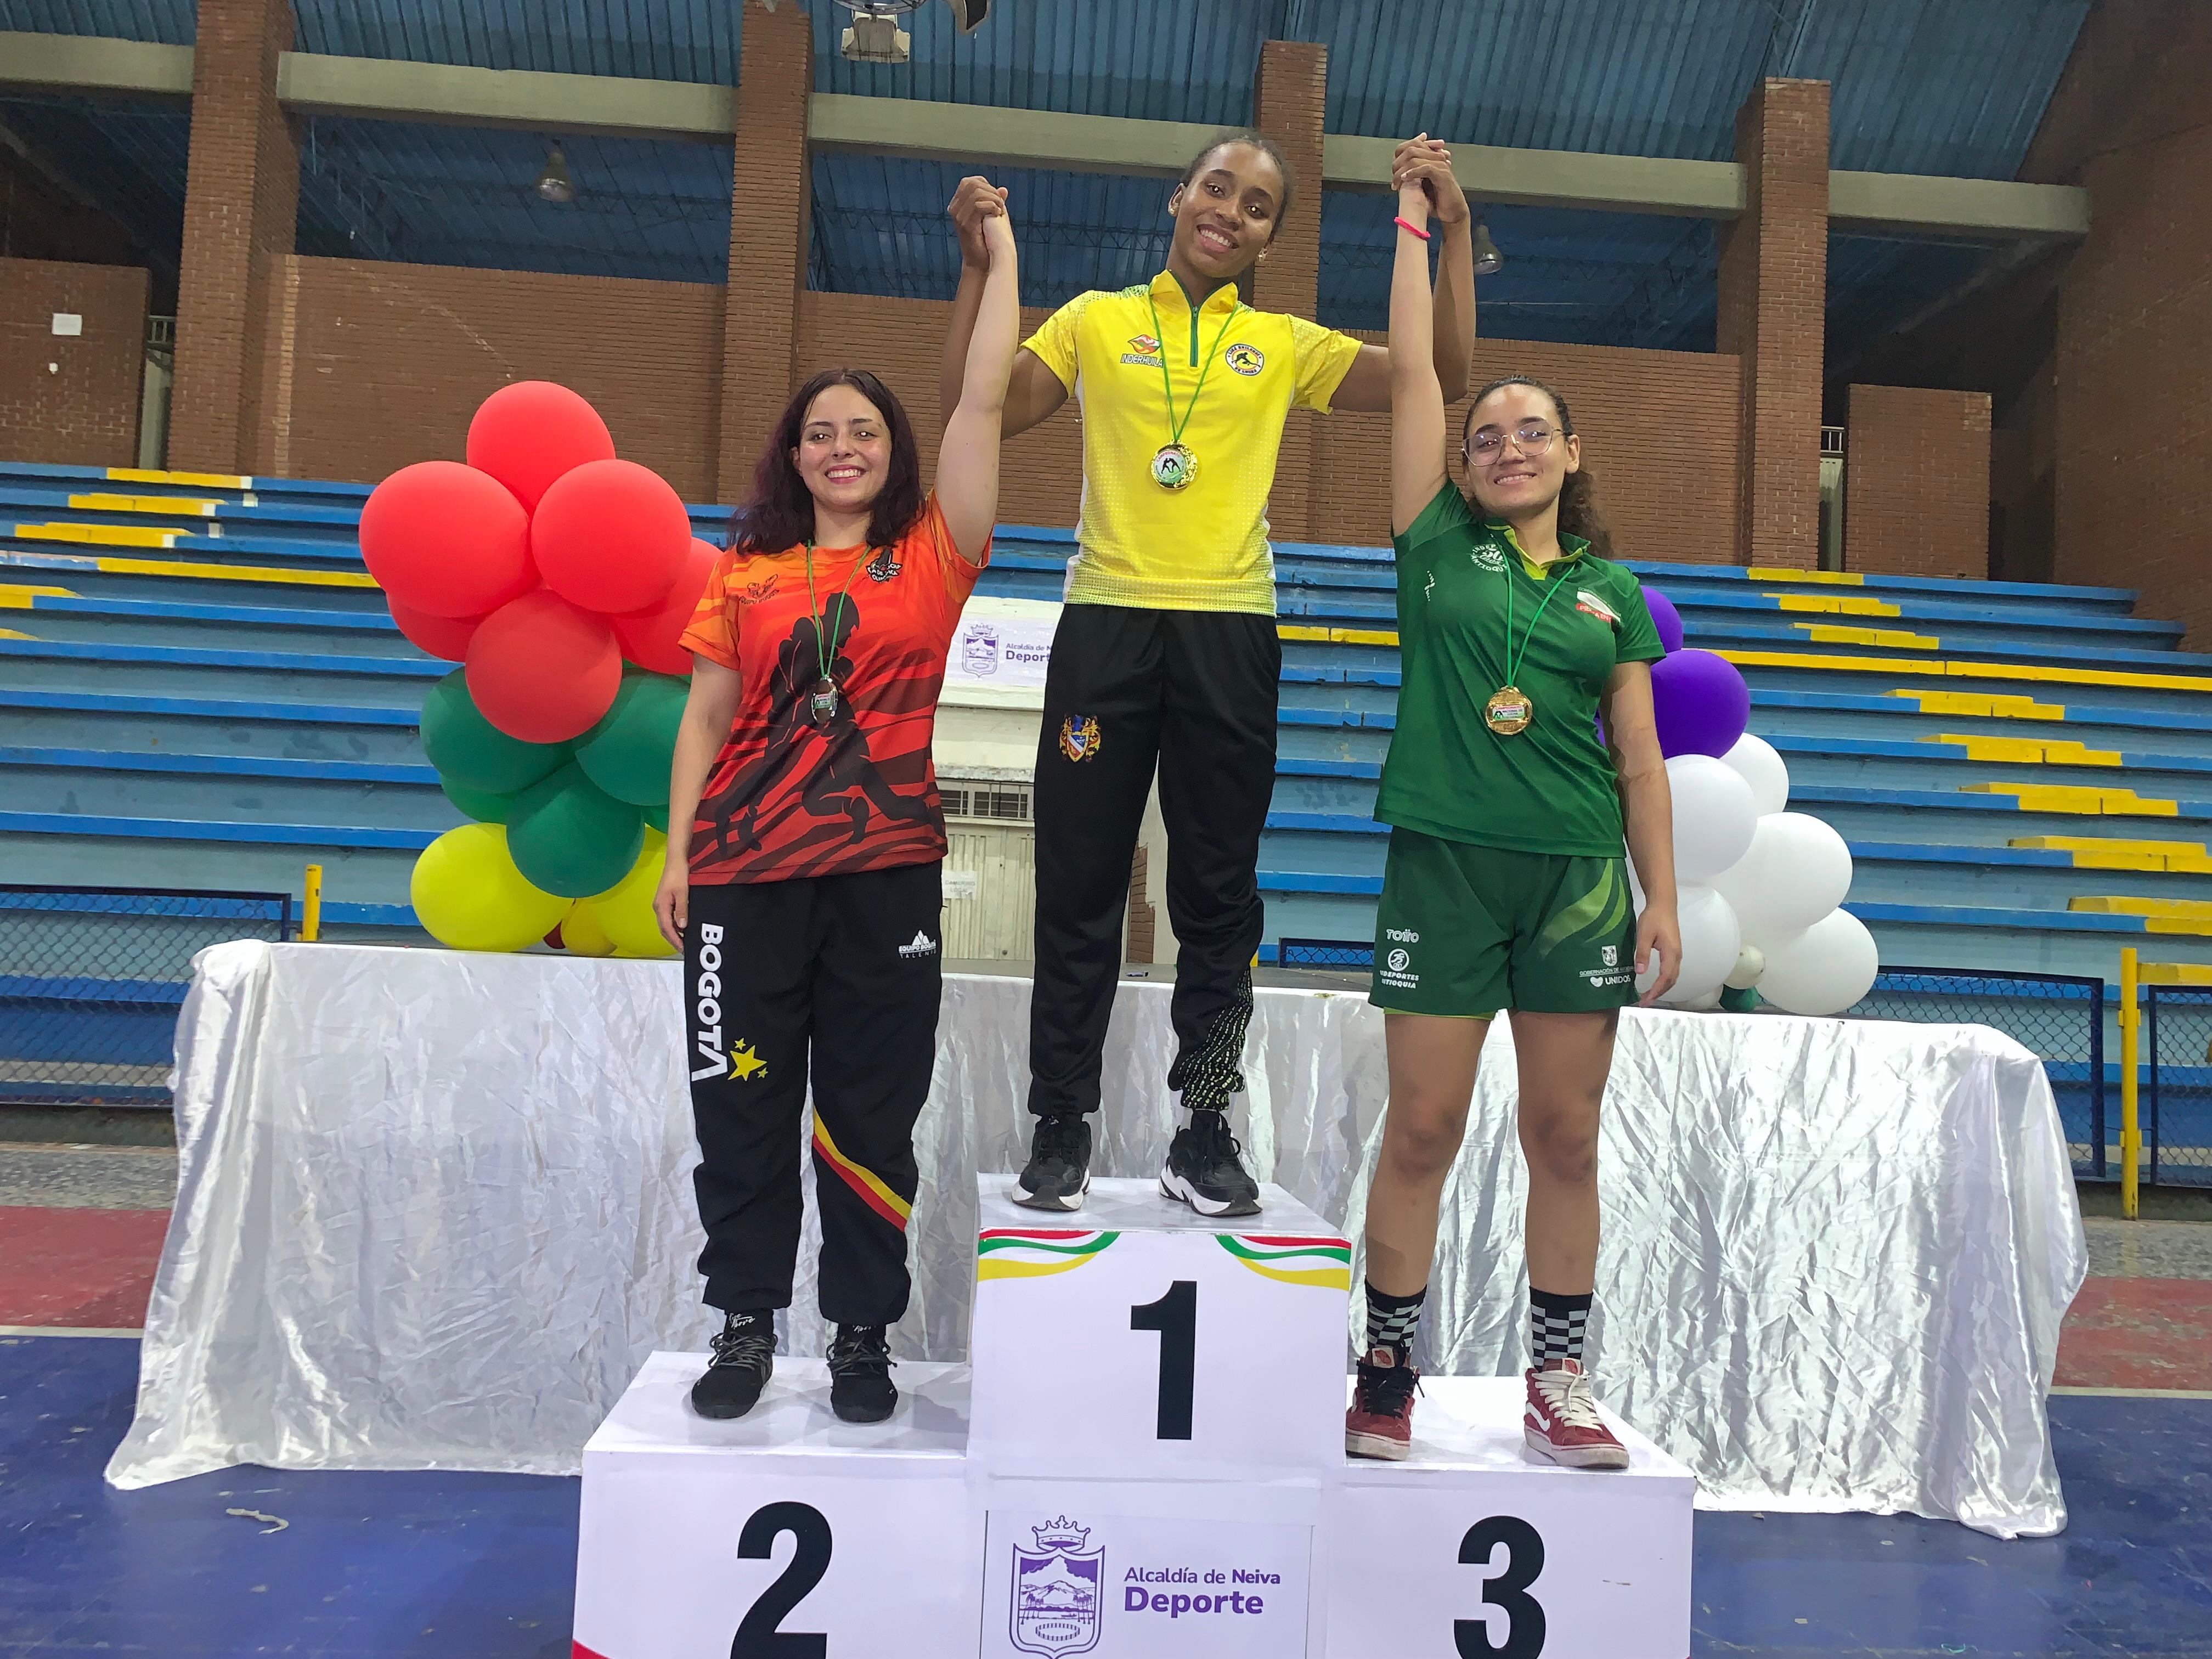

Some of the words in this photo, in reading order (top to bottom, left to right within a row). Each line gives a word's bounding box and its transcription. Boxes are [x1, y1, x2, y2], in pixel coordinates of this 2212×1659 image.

[1120, 353, 1163, 369] INDERHUILA
[1006, 642, 1034, 651] Alcaldía
[1006, 650, 1049, 663] Deport
[1605, 974, 1631, 985] UNIDOS
[1130, 1280, 1197, 1441] 1
[730, 1500, 832, 1659] 2
[1124, 1567, 1198, 1583] Alcaldía
[1204, 1569, 1226, 1584] de
[1232, 1569, 1280, 1584] Neiva
[1454, 1515, 1546, 1659] 3
[1125, 1587, 1263, 1618] Deporte
